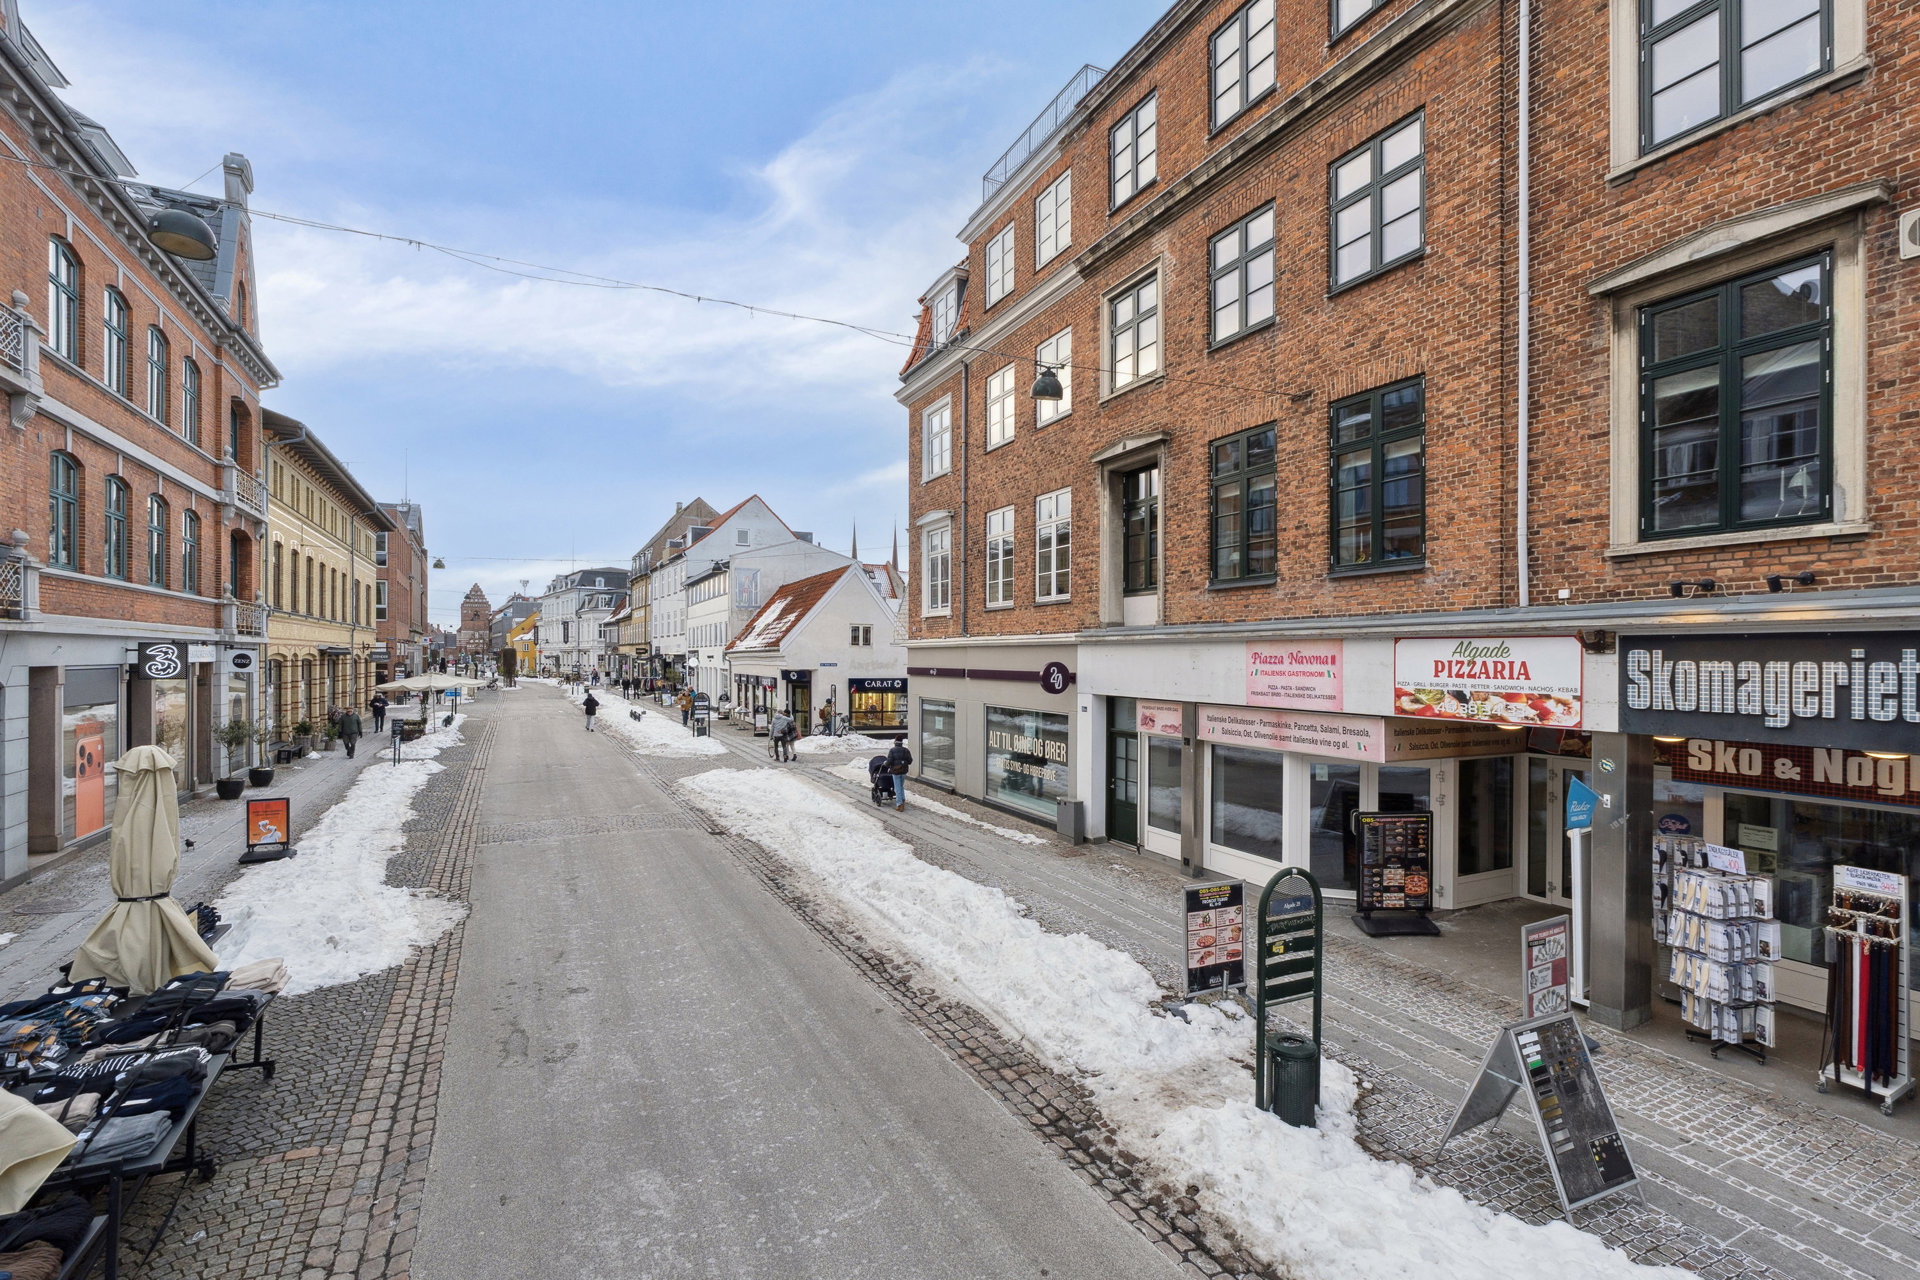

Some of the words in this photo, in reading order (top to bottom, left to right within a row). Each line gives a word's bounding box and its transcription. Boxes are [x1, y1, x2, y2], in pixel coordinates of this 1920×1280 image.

[1251, 651, 1284, 665] Piazza
[1287, 650, 1329, 665] Navona
[1452, 640, 1511, 667] Algade
[1433, 660, 1531, 681] PIZZARIA
[865, 680, 892, 688] CARAT
[1206, 714, 1227, 723] Italienske
[1227, 716, 1256, 726] Delikatesser
[1260, 718, 1293, 730] Parmaskinke,
[1294, 722, 1318, 733] Pancetta,
[1320, 724, 1341, 735] Salami,
[1342, 726, 1370, 738] Bresaola,
[1221, 726, 1242, 737] Salsiccia,
[1243, 729, 1253, 738] Ost,
[1253, 730, 1278, 741] Olivenolie
[1279, 733, 1292, 742] samt
[1293, 735, 1318, 745] italienske
[1320, 738, 1331, 747] vine
[1332, 741, 1341, 749] og
[989, 730, 1001, 748] ALT
[1002, 732, 1012, 751] TIL
[1014, 734, 1032, 755] ØJNE
[1033, 738, 1043, 757] OG
[1045, 740, 1067, 763] ØRER
[1688, 739, 1762, 776] Sko
[1774, 758, 1801, 781] &
[1283, 902, 1296, 910] Algade
